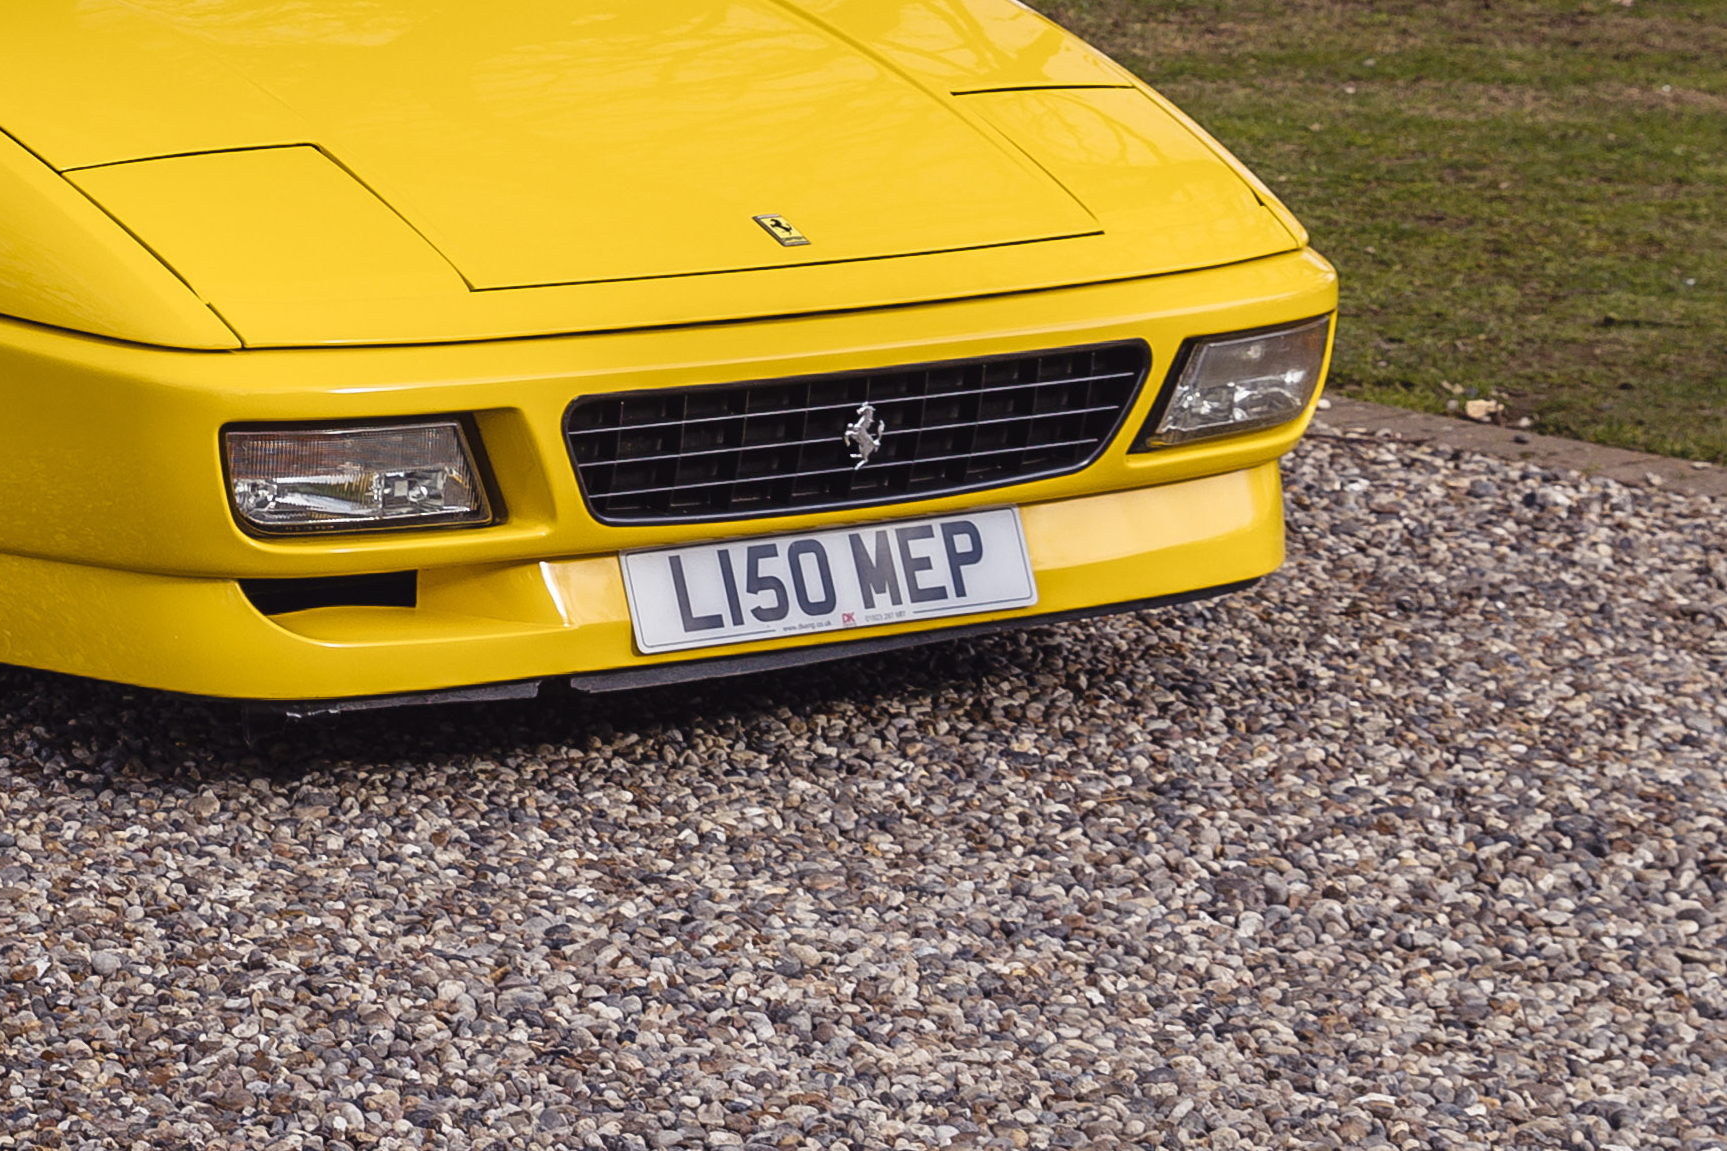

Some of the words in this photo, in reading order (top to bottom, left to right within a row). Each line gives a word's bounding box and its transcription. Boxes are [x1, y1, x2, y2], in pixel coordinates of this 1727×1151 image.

[669, 539, 836, 632] L150
[849, 520, 983, 609] MEP
[842, 612, 855, 623] DK
